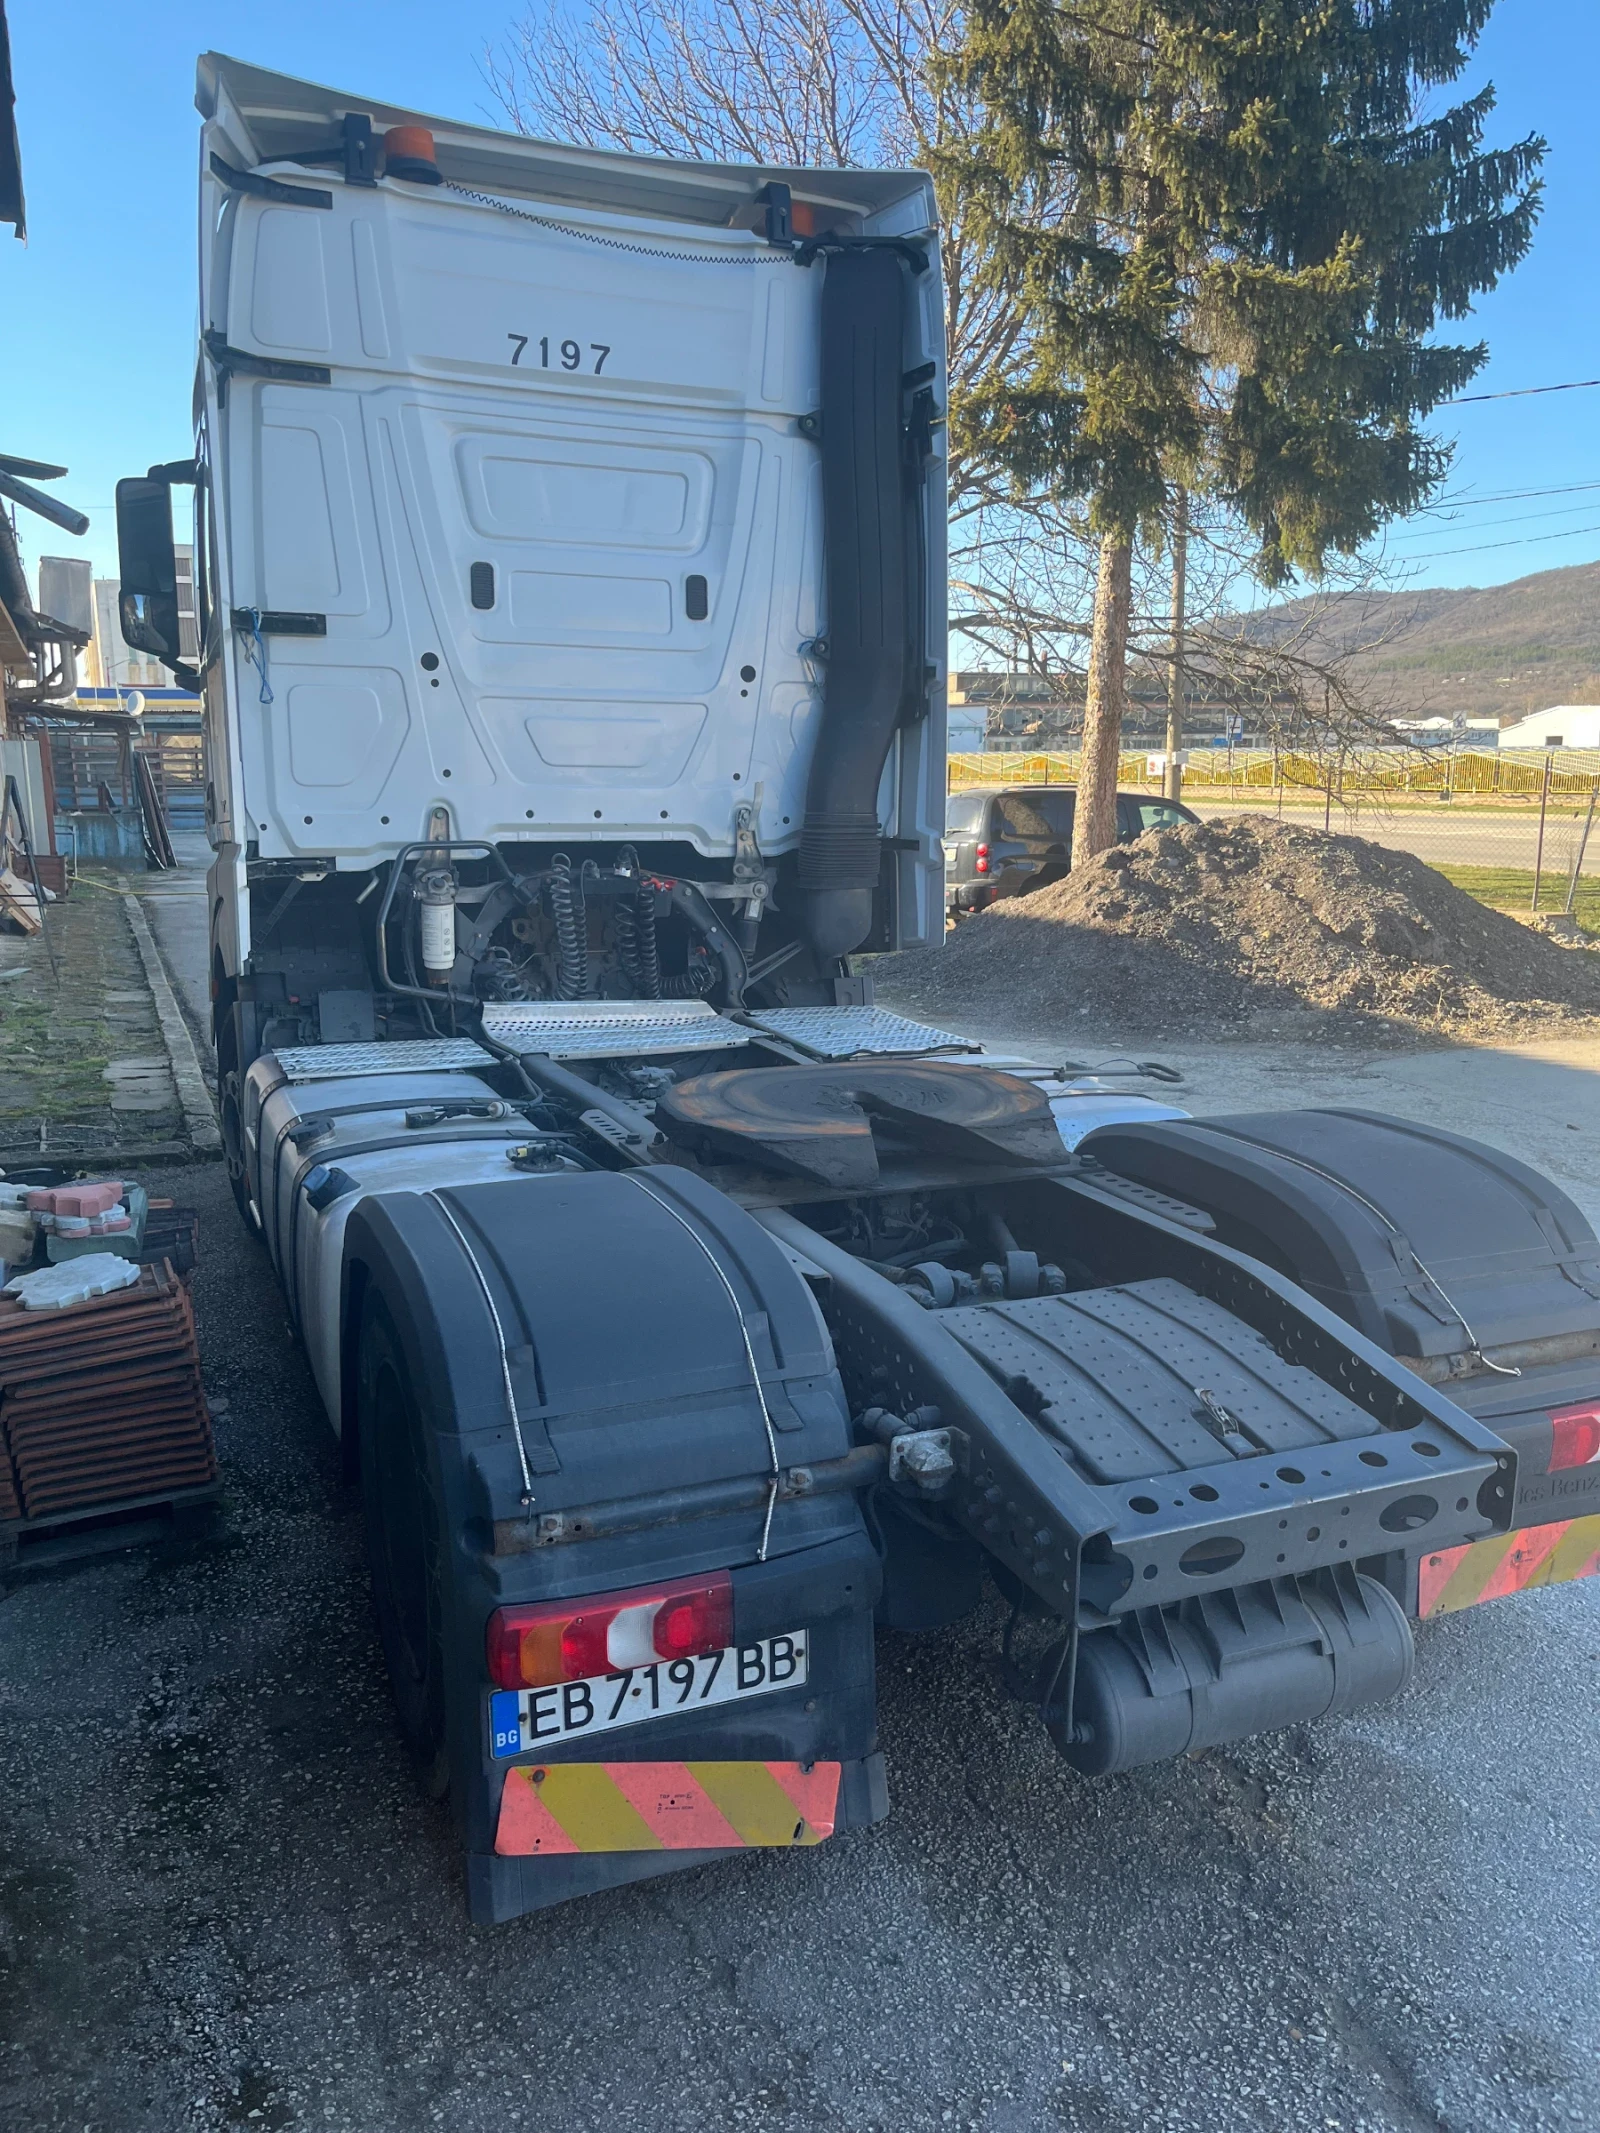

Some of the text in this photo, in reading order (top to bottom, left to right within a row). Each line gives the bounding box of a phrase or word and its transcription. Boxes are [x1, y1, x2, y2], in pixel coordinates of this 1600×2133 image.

[507, 333, 611, 375] 7197
[529, 1636, 797, 1740] EB 7197 BB
[496, 1729, 518, 1748] BG
